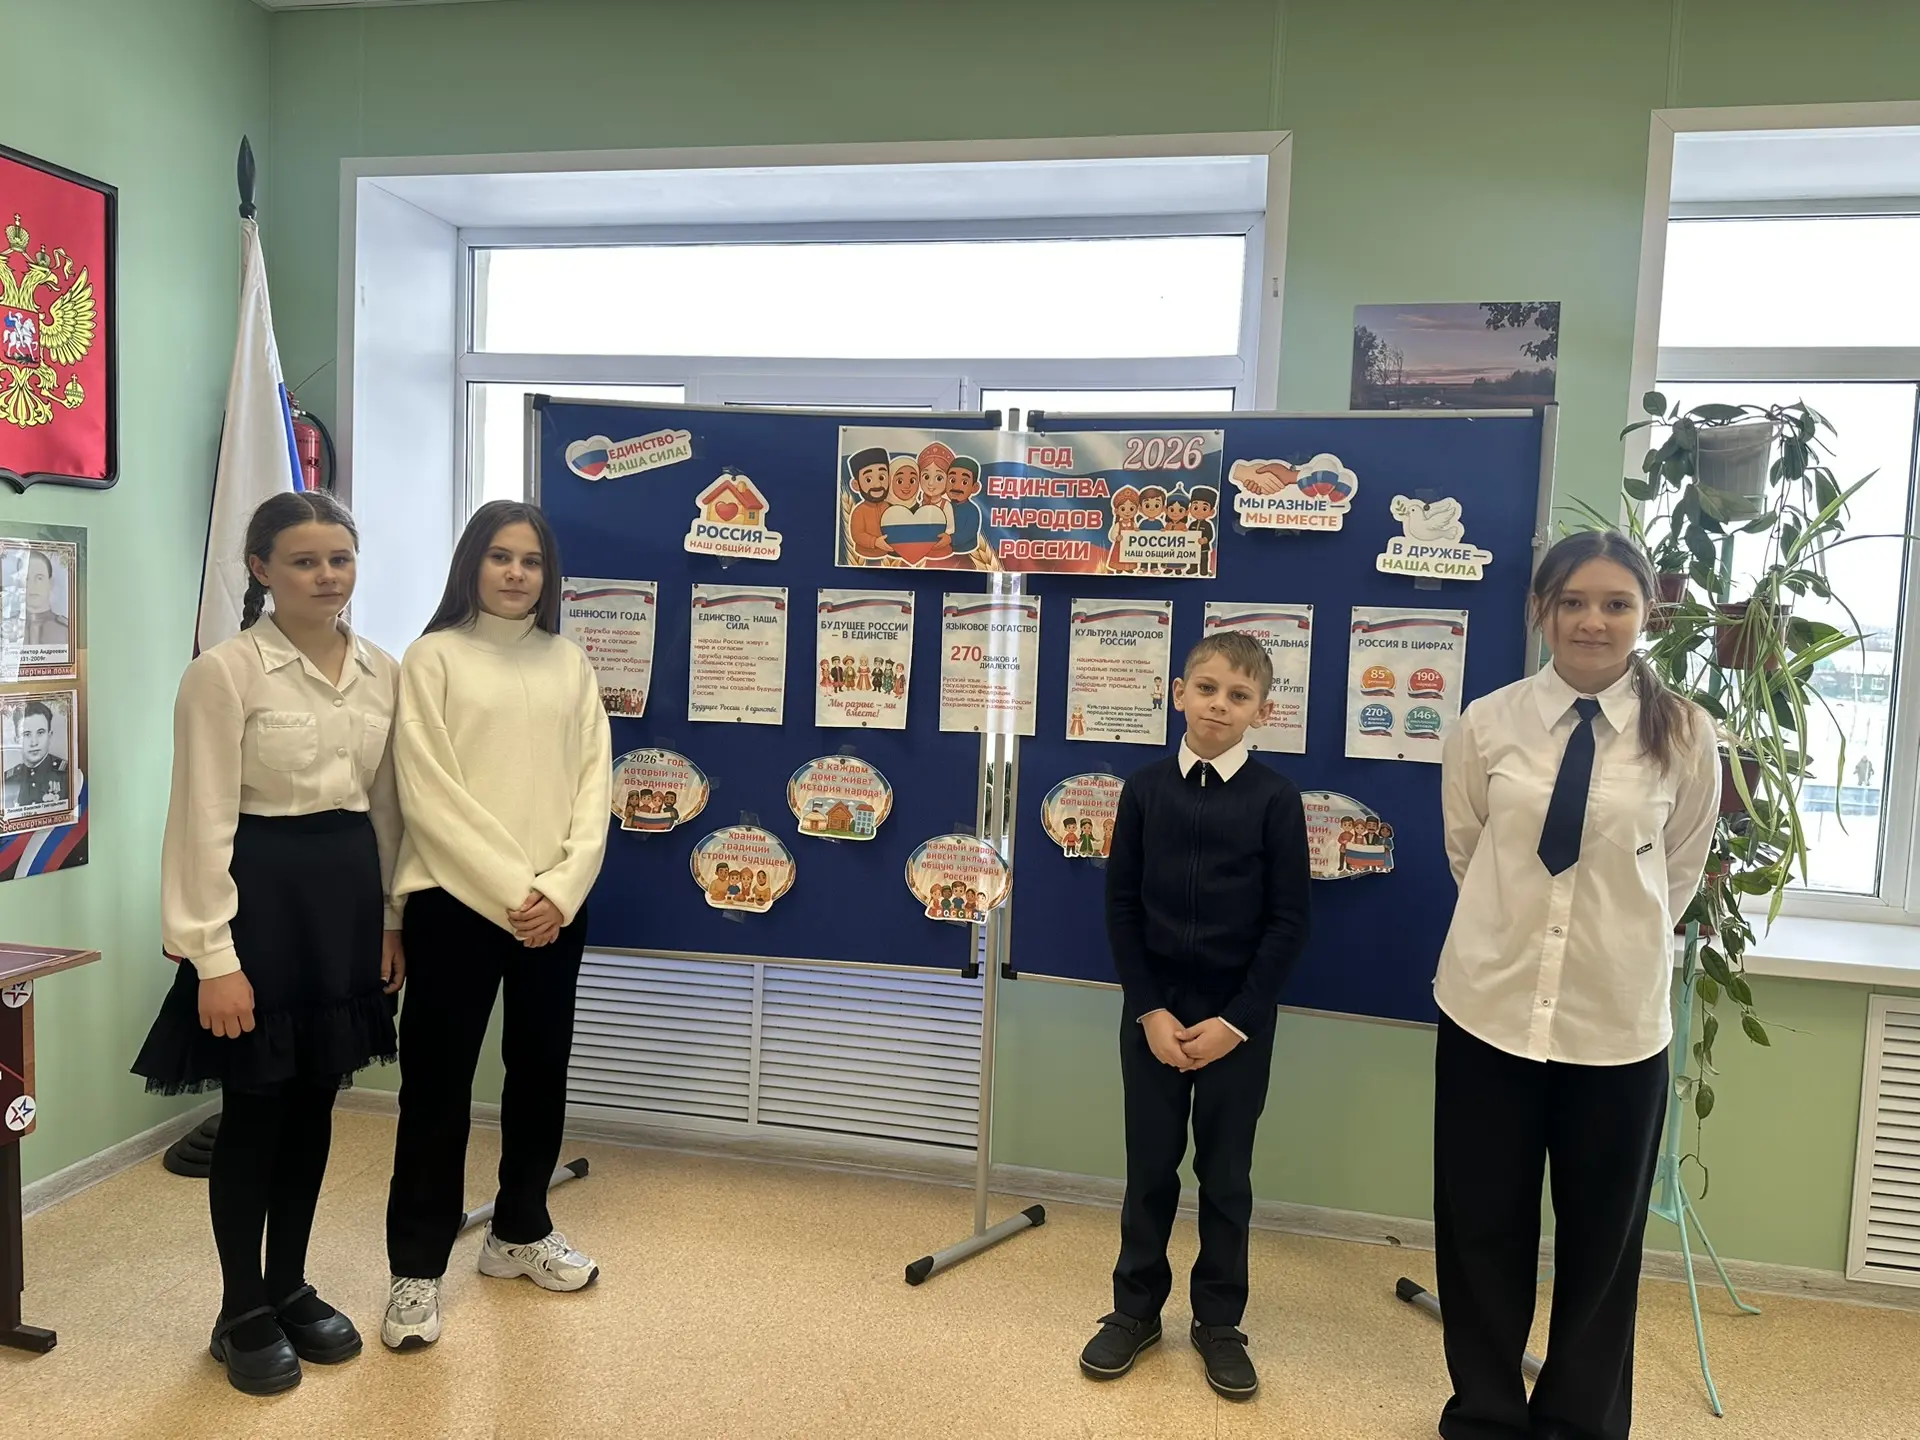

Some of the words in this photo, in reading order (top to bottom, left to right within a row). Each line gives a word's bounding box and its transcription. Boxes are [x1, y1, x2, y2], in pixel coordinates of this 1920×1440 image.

[608, 434, 674, 460] ЕДИНСТВО
[1027, 446, 1073, 468] ГОД
[1123, 436, 1205, 471] 2026
[609, 457, 647, 475] НАША
[650, 446, 688, 464] СИЛА!
[987, 476, 1110, 499] ЕДИНСТВА
[1239, 498, 1264, 509] МЫ
[1267, 499, 1327, 511] РАЗНЫЕ
[991, 508, 1102, 530] НАРОДОВ
[1245, 512, 1272, 524] МЫ
[1276, 513, 1337, 527] ВМЕСТЕ
[696, 524, 762, 543] РОССИЯ
[1128, 536, 1185, 548] РОССИЯ
[689, 540, 712, 549] НАШ
[753, 546, 776, 556] ДОМ
[1000, 539, 1091, 560] РОССИИ
[1392, 543, 1403, 555] В
[1406, 546, 1471, 561] ДРУЖБЕ
[1145, 549, 1175, 559] ОБЩИЙ
[1177, 550, 1196, 559] ДОМ
[1382, 558, 1430, 572] НАША
[1434, 563, 1477, 576] СИЛА
[569, 609, 617, 619] ЦЕННОСТИ
[620, 612, 647, 621] ГОДА
[698, 613, 741, 622] ЕДИНСТВО
[753, 615, 778, 624] НАША
[726, 622, 749, 630] СИЛА
[821, 620, 865, 630] БУДУЩЕЕ
[868, 622, 908, 631] РОССИИ
[945, 622, 988, 631] ЯЗЫКОВОЕ
[991, 623, 1038, 633] БОГАТСТВО
[842, 631, 848, 639] В
[852, 631, 898, 640] ЕДИНСТВЕ
[1075, 628, 1118, 637] КУЛЬТУРА
[1120, 630, 1163, 639] НАРОДОВ
[1100, 638, 1136, 646] РОССИИ
[1358, 639, 1399, 648] РОССИЯ
[1411, 641, 1454, 650] ЦИФРАХ
[951, 645, 982, 662] 270
[979, 662, 1020, 670] ДИАЛЕКТОВ
[1370, 670, 1385, 678] 85
[1416, 672, 1440, 681] 190+
[1280, 685, 1304, 693] ГРУПП
[828, 698, 843, 708] Мы
[844, 701, 874, 712] разные
[846, 709, 880, 718] вместе!
[1365, 708, 1388, 716] 270+
[1413, 711, 1436, 719] 146+
[630, 754, 657, 764] 2026
[624, 767, 668, 778] который
[672, 771, 689, 779] нас
[827, 764, 868, 774] каждом
[810, 773, 837, 782] доме
[841, 775, 873, 785] живет
[1077, 779, 1118, 788] Каждый
[800, 783, 841, 793] история
[1065, 789, 1093, 797] народ
[1060, 798, 1102, 806] большой
[1079, 809, 1115, 817] России!
[3, 818, 53, 832] Бессмертный
[728, 831, 766, 842] Храним
[721, 843, 770, 854] традиции
[928, 842, 966, 852] Каждый
[969, 846, 996, 856] народ
[701, 852, 739, 861] строим
[961, 856, 988, 864] вклад
[921, 861, 954, 870] общую
[957, 865, 1000, 876] культуру
[943, 873, 977, 882] России!
